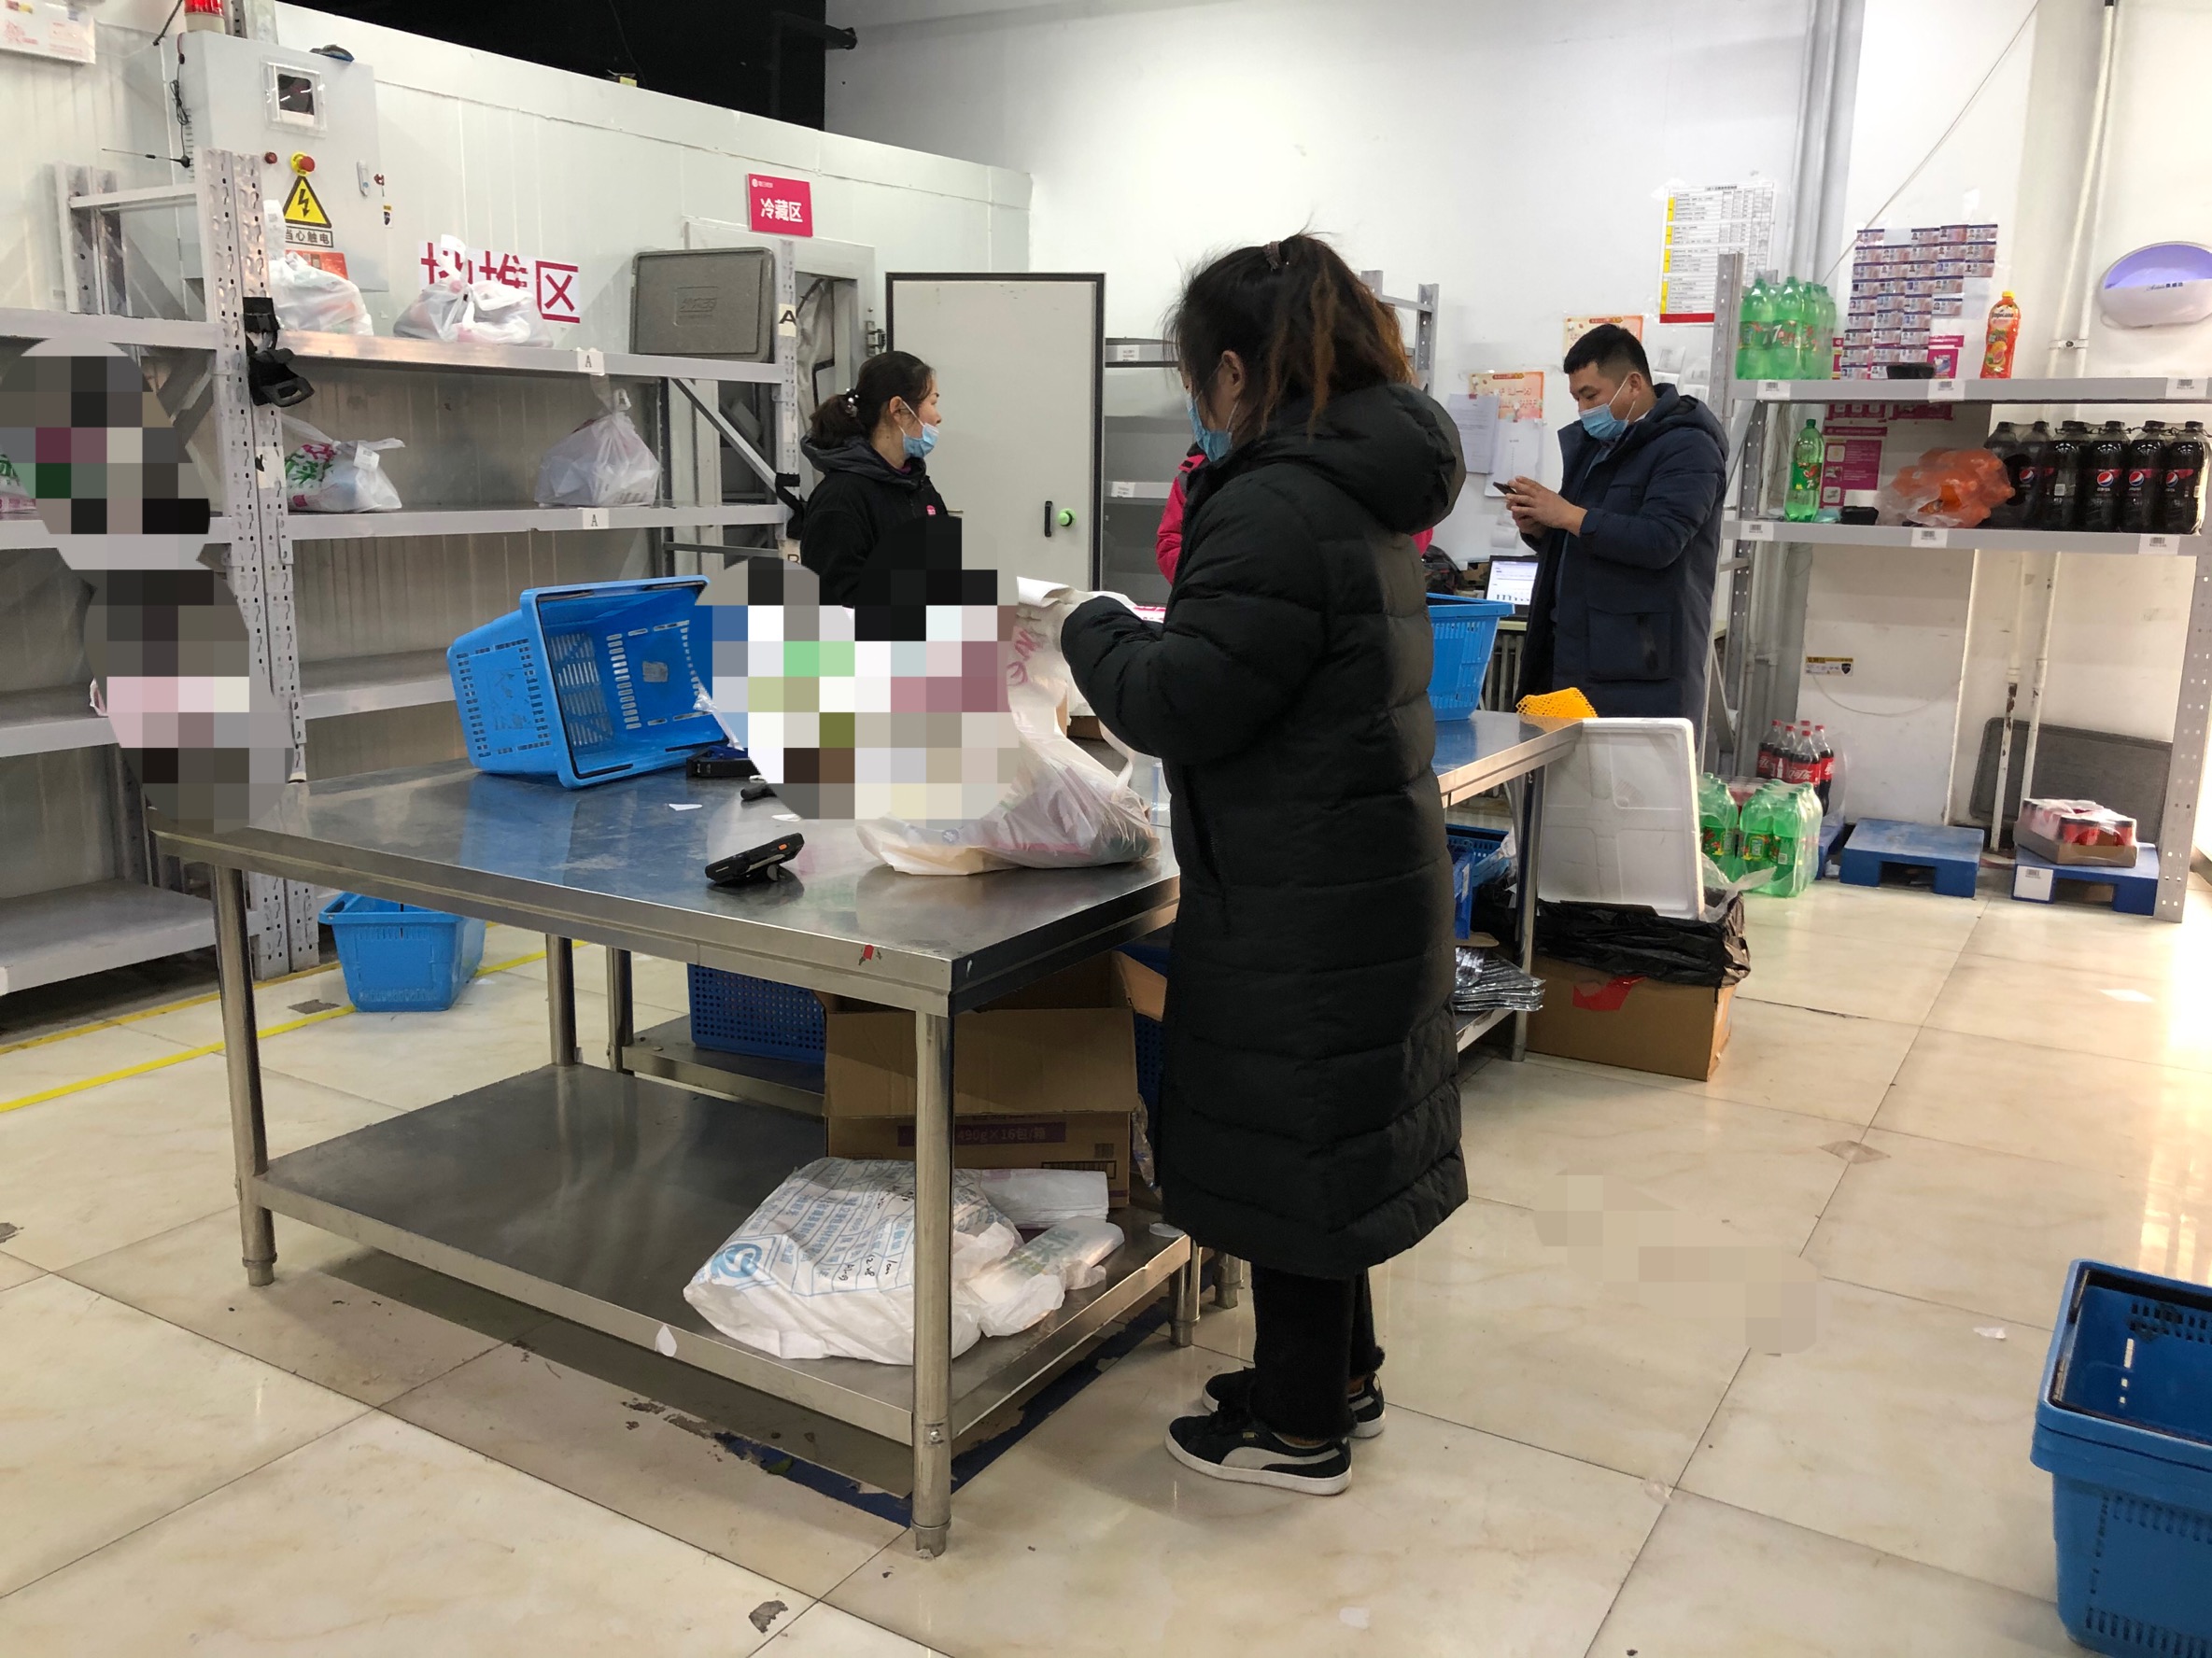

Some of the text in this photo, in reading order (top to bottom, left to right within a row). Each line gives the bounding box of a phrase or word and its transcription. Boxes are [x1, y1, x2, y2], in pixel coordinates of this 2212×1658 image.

[760, 197, 803, 223] 冷藏区
[285, 228, 330, 245] 当心触电
[779, 309, 796, 327] A
[585, 354, 593, 369] A
[590, 513, 599, 527] A
